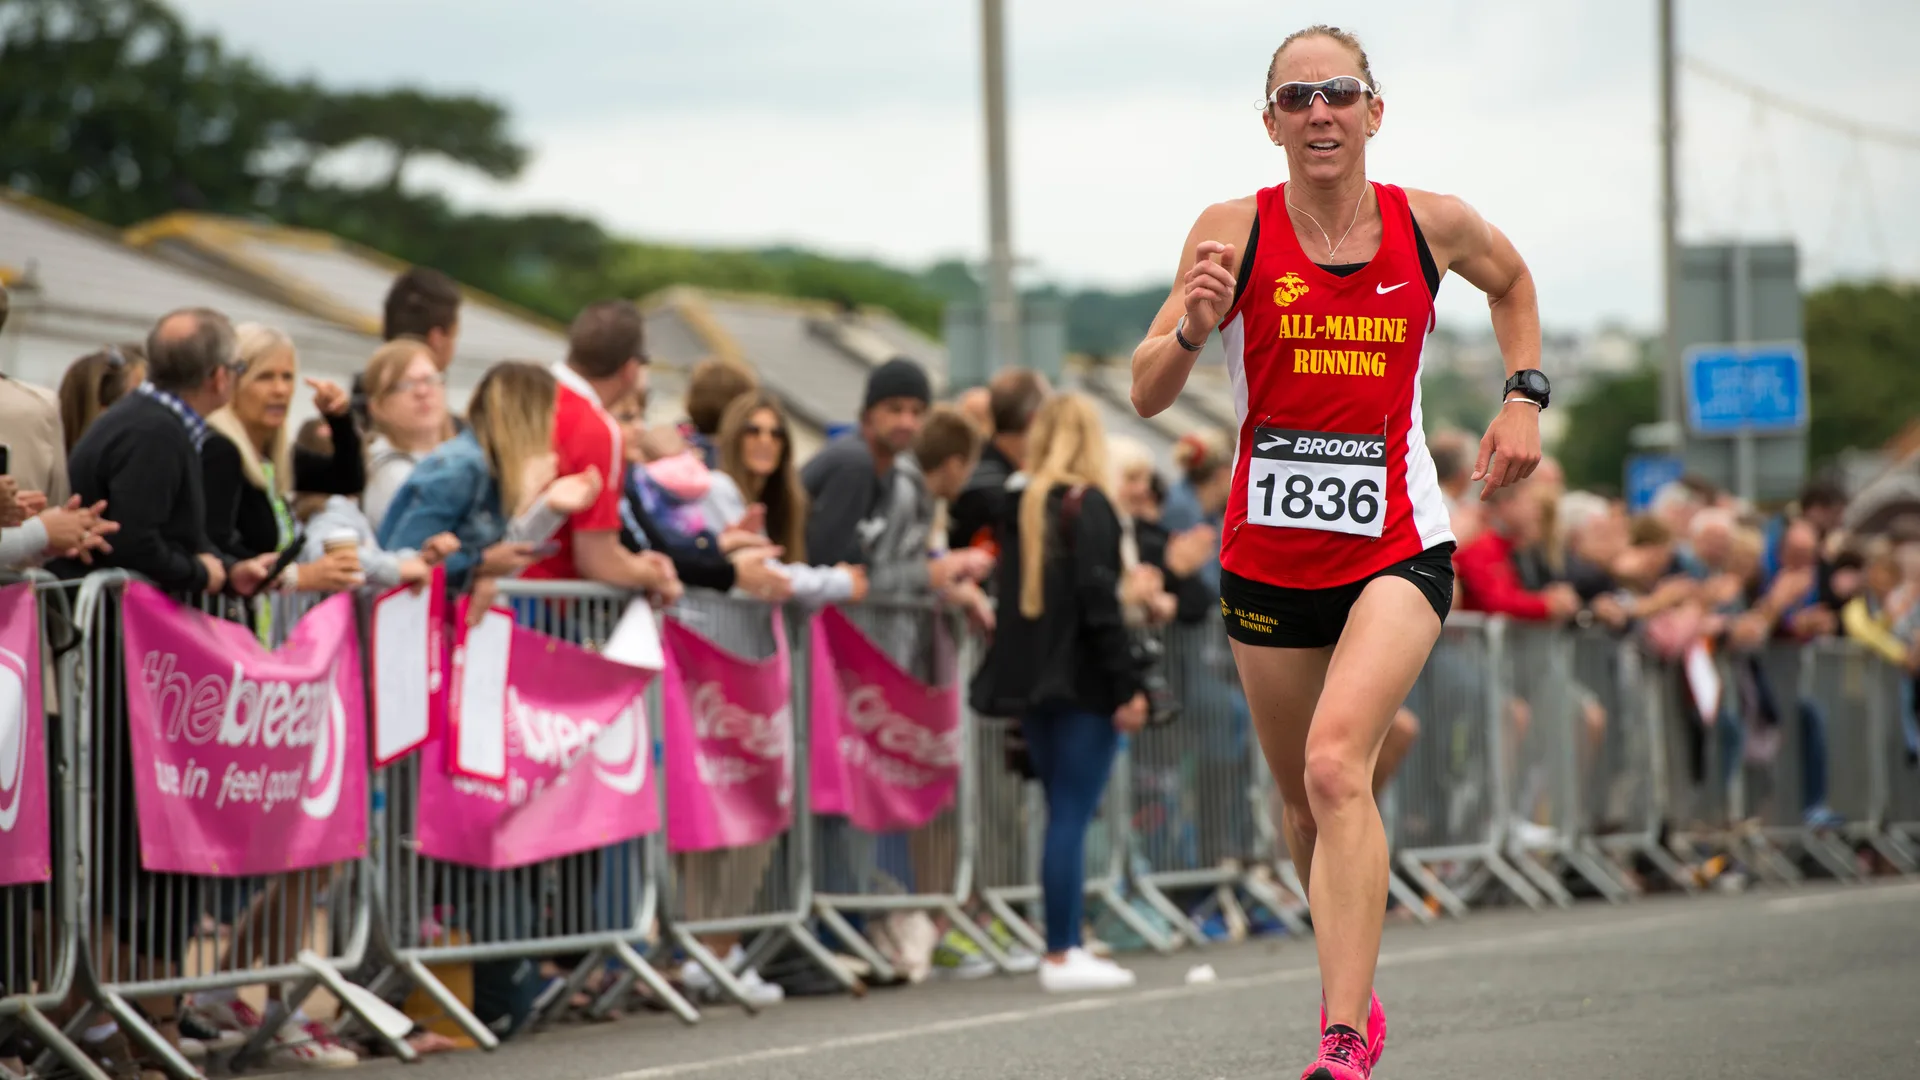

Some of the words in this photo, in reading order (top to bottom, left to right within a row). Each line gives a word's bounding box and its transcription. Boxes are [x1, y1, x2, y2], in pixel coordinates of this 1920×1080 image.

[1279, 314, 1407, 343] ALL-MARINE
[1293, 348, 1386, 377] RUNNING
[1293, 437, 1385, 458] BROOKS
[1256, 473, 1380, 524] 1836
[1234, 607, 1279, 626] ALL-MARINE
[1239, 618, 1273, 634] RUNNING
[181, 757, 210, 799] in
[215, 761, 268, 810] feel
